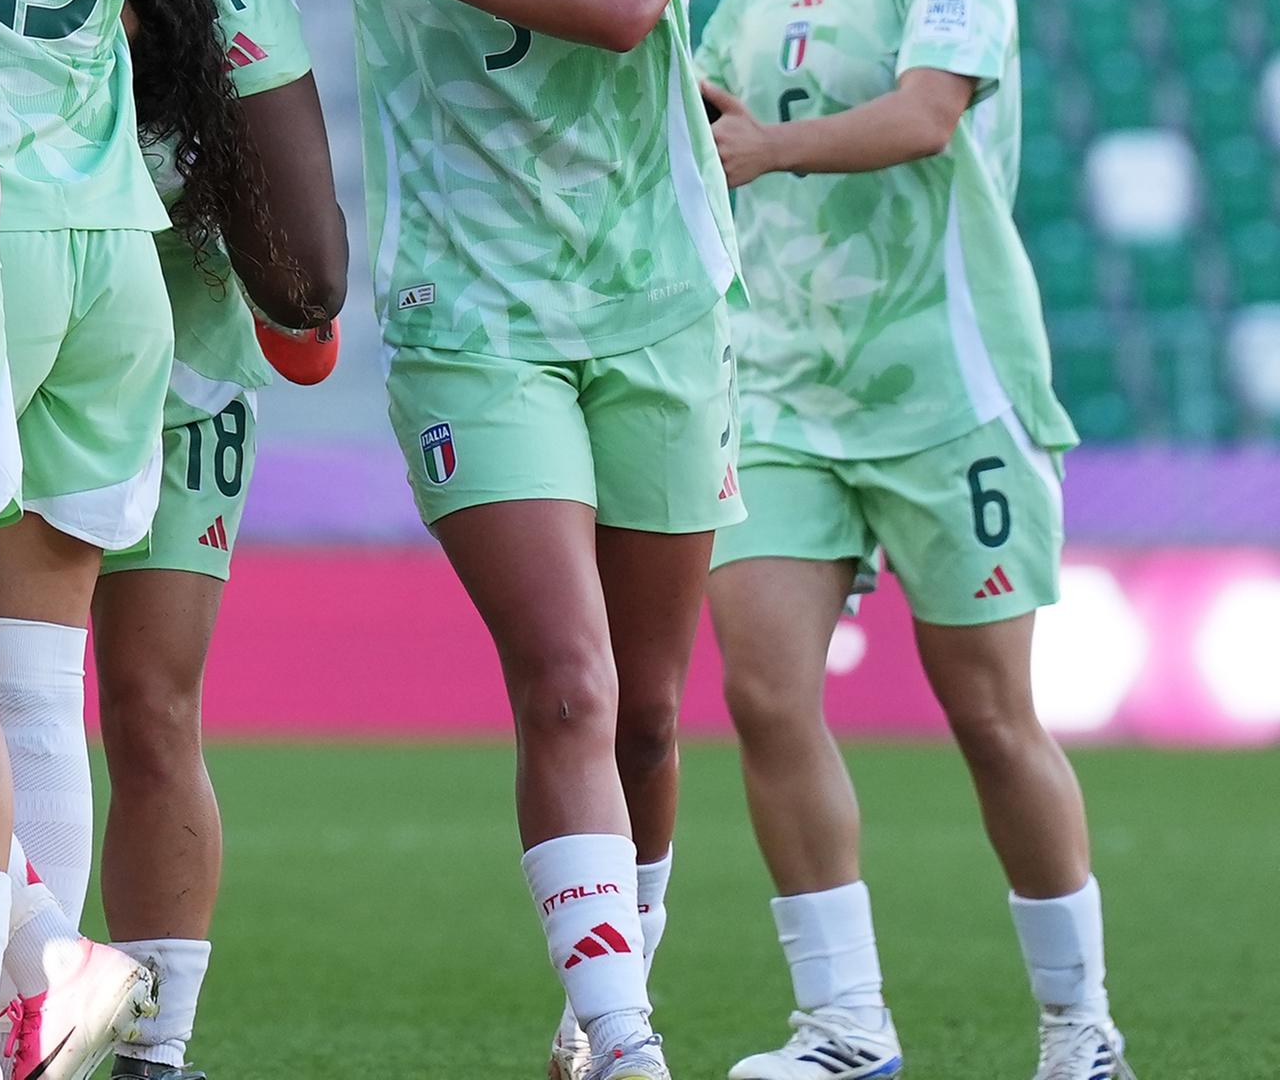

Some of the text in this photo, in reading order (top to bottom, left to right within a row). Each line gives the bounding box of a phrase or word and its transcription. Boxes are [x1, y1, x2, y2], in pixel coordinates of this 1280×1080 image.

[185, 399, 246, 497] 18
[422, 425, 450, 448] ITALIA
[968, 456, 1011, 548] 6
